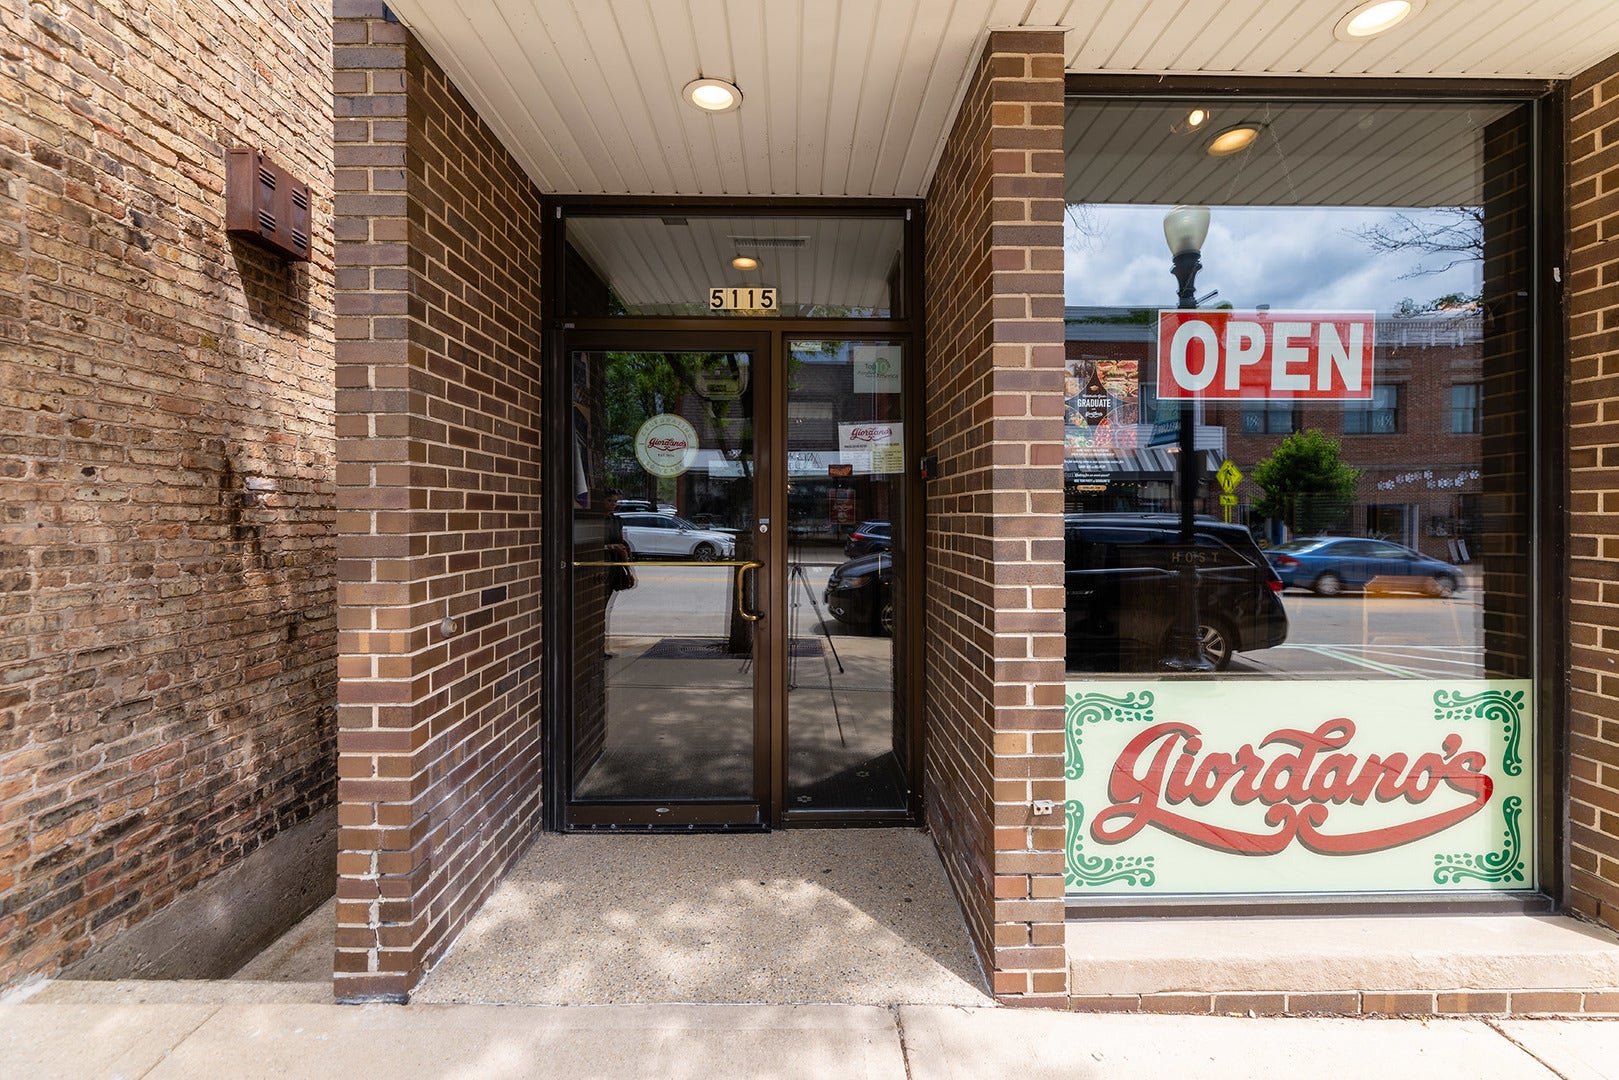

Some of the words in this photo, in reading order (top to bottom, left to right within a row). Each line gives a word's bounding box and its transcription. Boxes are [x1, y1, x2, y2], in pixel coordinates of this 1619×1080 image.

[711, 289, 773, 308] 5115
[1169, 320, 1365, 392] OPEN
[1077, 398, 1111, 407] GRADUATE
[647, 437, 687, 452] Giordano's
[1171, 551, 1219, 563] HOST
[1089, 717, 1494, 857] Giordano's
